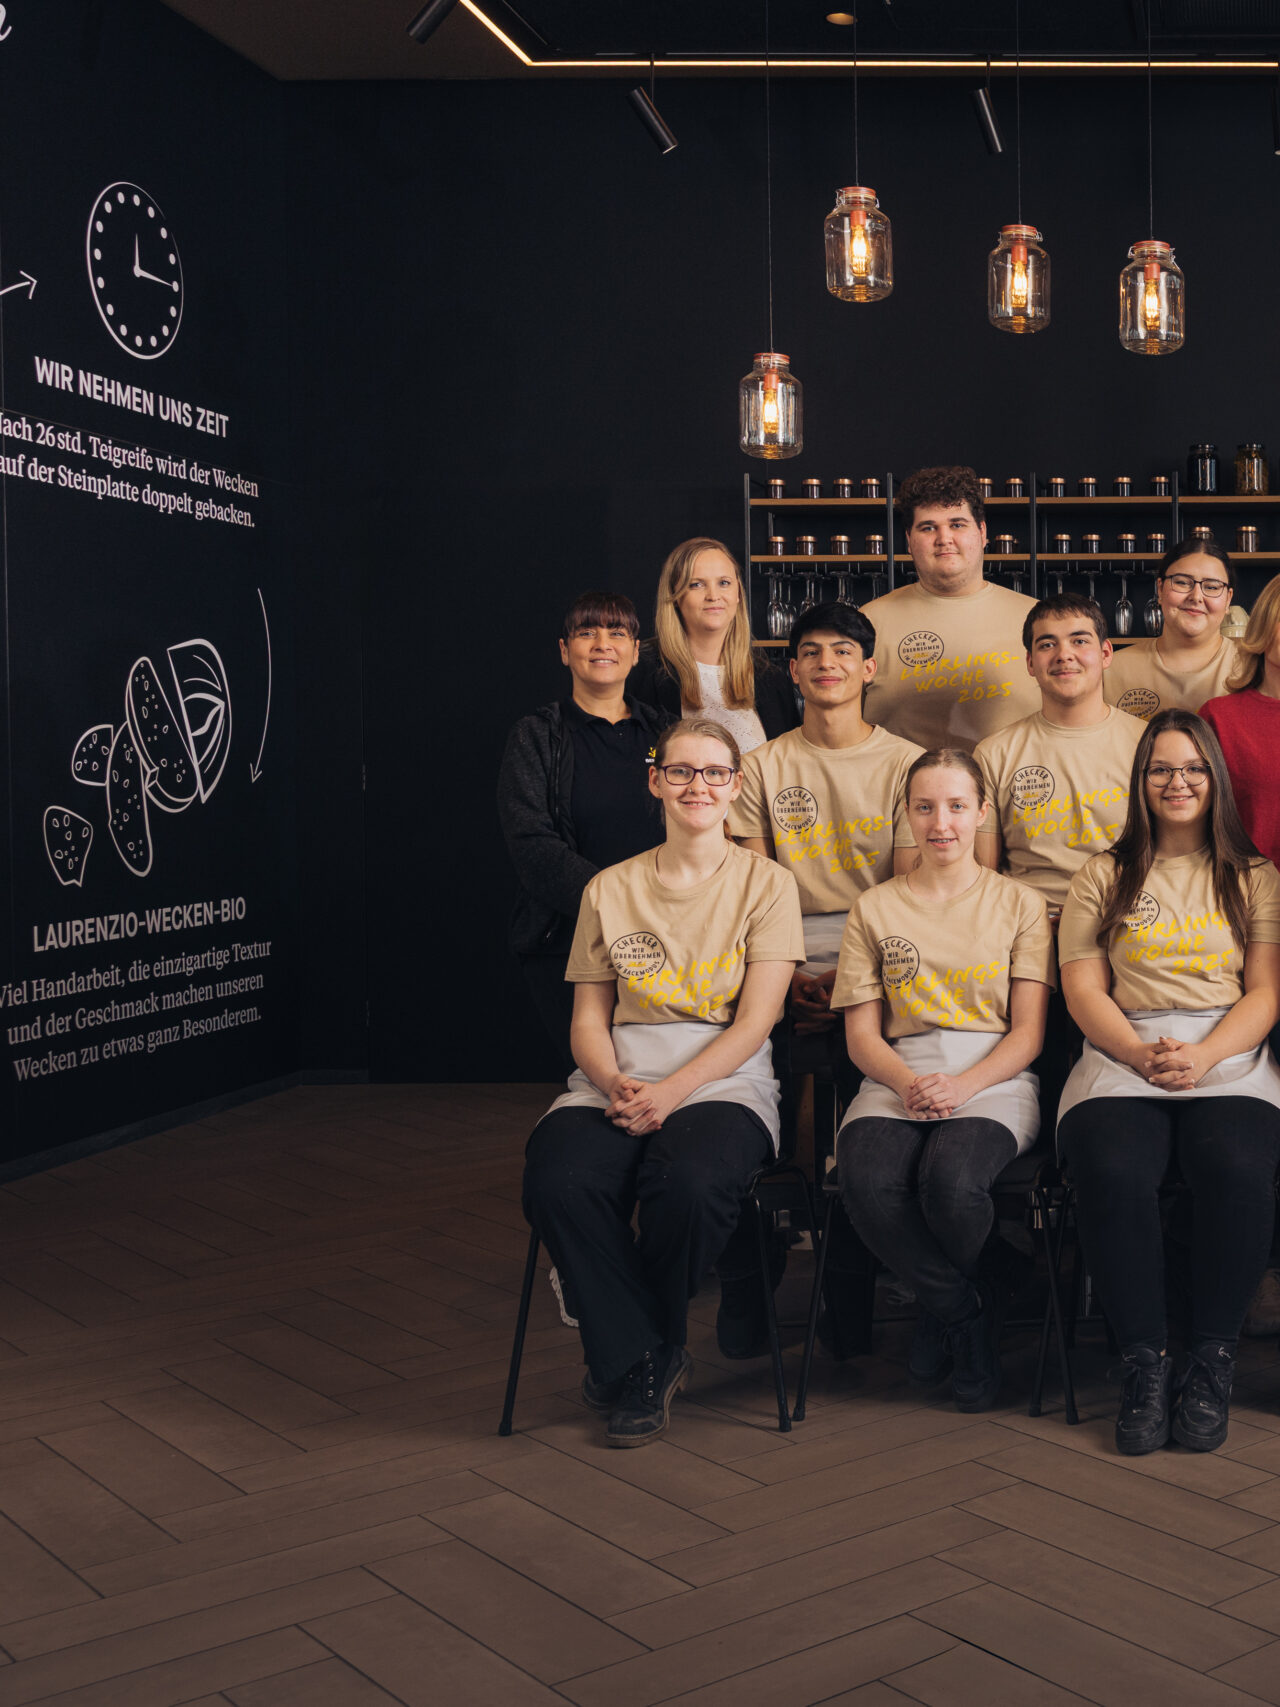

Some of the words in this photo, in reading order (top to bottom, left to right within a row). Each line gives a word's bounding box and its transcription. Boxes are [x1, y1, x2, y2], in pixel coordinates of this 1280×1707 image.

[34, 355, 74, 392] WIR
[79, 369, 155, 417] NEHMEN
[159, 395, 193, 428] UNS
[196, 406, 229, 438] ZEIT
[36, 423, 55, 447] 26
[57, 431, 86, 455] std.
[89, 435, 153, 472] Teigreife
[156, 456, 187, 480] wird
[189, 462, 211, 485] der
[212, 468, 259, 498] Wecken
[27, 457, 55, 484] der
[58, 465, 139, 502] Steinplatte
[142, 484, 193, 515] doppelt
[195, 499, 255, 528] gebacken.
[903, 633, 938, 646] CHECKER
[915, 669, 985, 692] WOCHE
[958, 681, 1014, 703] 2025
[1014, 768, 1048, 782] CHECKER
[777, 789, 811, 805] CHECKER
[1025, 809, 1092, 840] WOCHE
[1067, 823, 1119, 848] 2025
[790, 838, 852, 863] WOCHE
[830, 850, 880, 873] 2025
[33, 896, 246, 952] LAURENZIO-WECKEN-BIO
[617, 935, 658, 950] CHECKER
[881, 939, 912, 954] ECKER
[1126, 934, 1206, 963] WOCHE
[31, 964, 125, 1002] Handarbeit,
[128, 959, 150, 982] die
[153, 946, 230, 977] einzigartige
[231, 940, 272, 963] Textur
[627, 947, 745, 993] EHRLINGS-
[1171, 948, 1234, 975] 2025
[888, 961, 1007, 1001] EHRLINGS-
[7, 1016, 42, 1045] und
[45, 1012, 72, 1037] der
[75, 992, 160, 1029] Geschmack
[161, 981, 214, 1010] machen
[215, 973, 264, 998] unseren
[896, 987, 965, 1019] WOCHE
[938, 999, 992, 1027] 2025
[13, 1050, 78, 1081] Wecken
[81, 1045, 100, 1065] zu
[102, 1033, 145, 1059] etwas
[147, 1025, 180, 1053] ganz
[183, 1006, 262, 1039] Besonderem.
